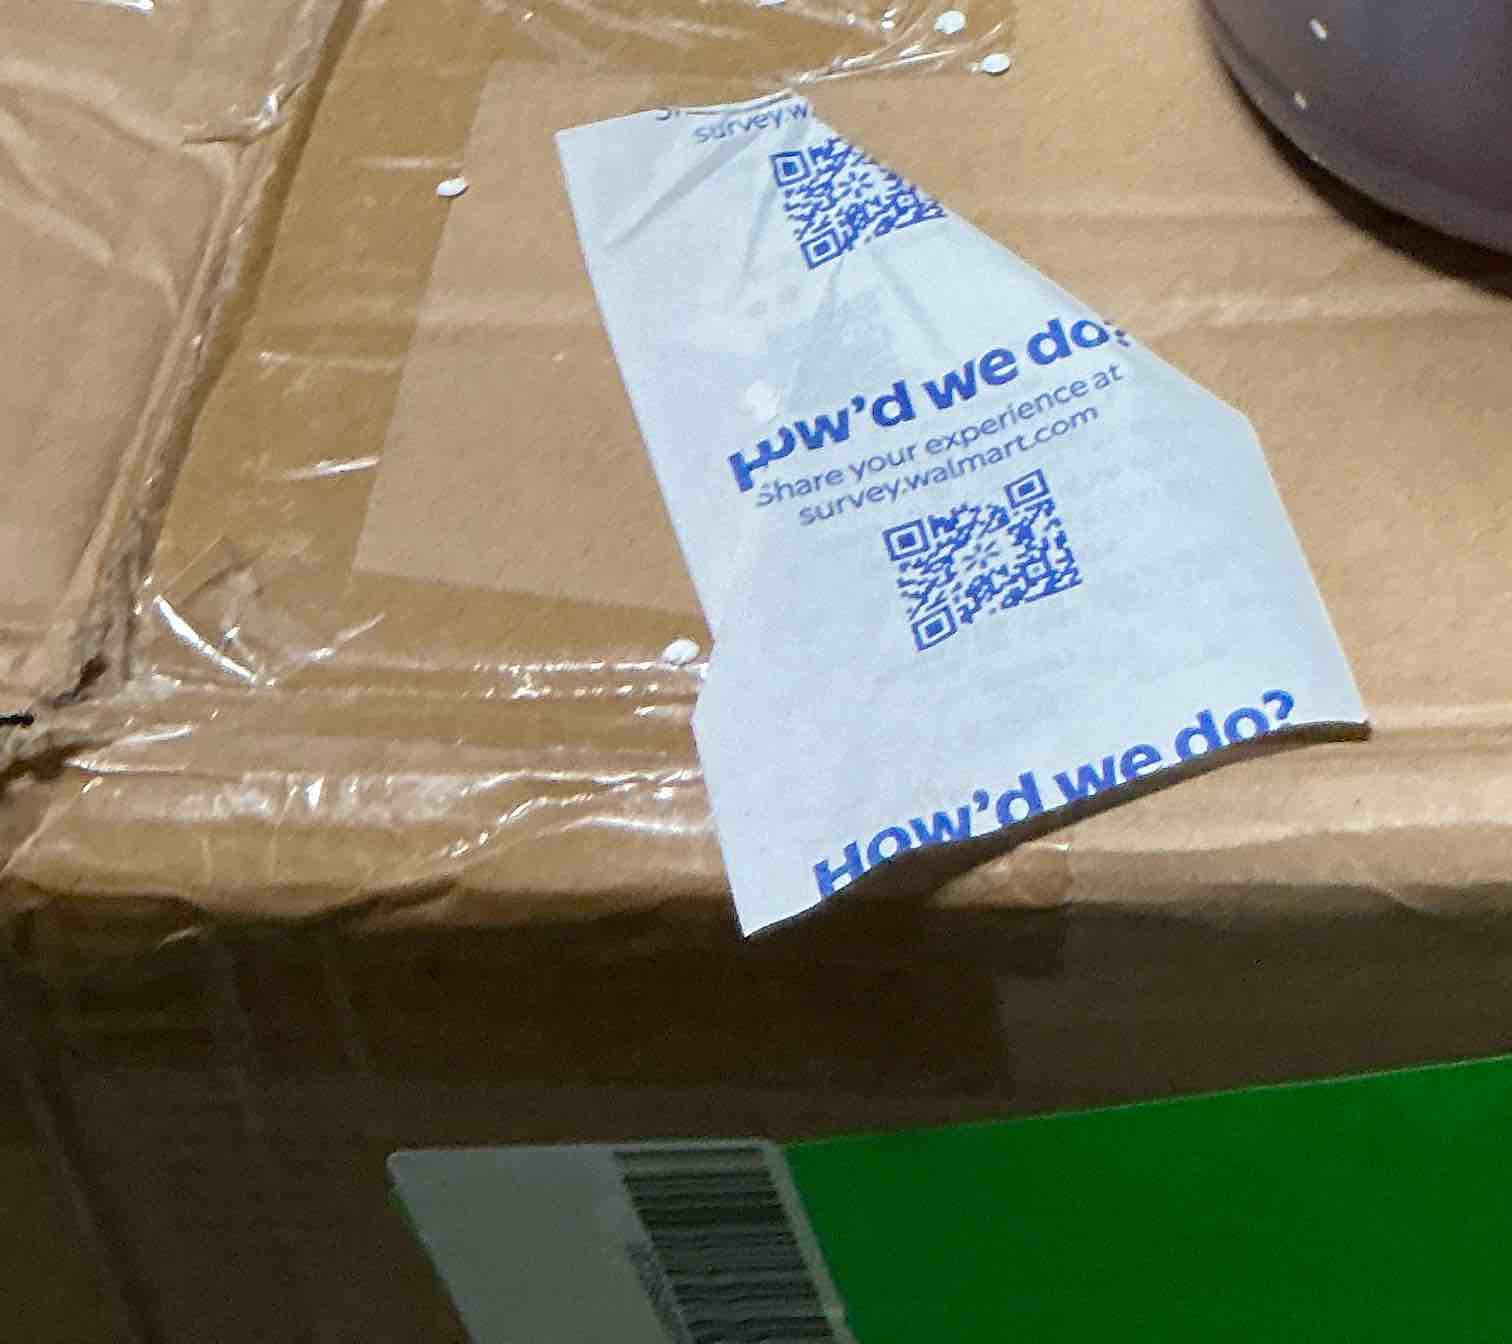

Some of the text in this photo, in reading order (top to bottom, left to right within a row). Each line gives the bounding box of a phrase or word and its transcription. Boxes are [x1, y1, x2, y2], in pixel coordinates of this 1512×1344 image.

[757, 362, 1123, 508] Share your experience at
[922, 346, 1018, 410] we
[800, 405, 1099, 526] survey.walmart.com
